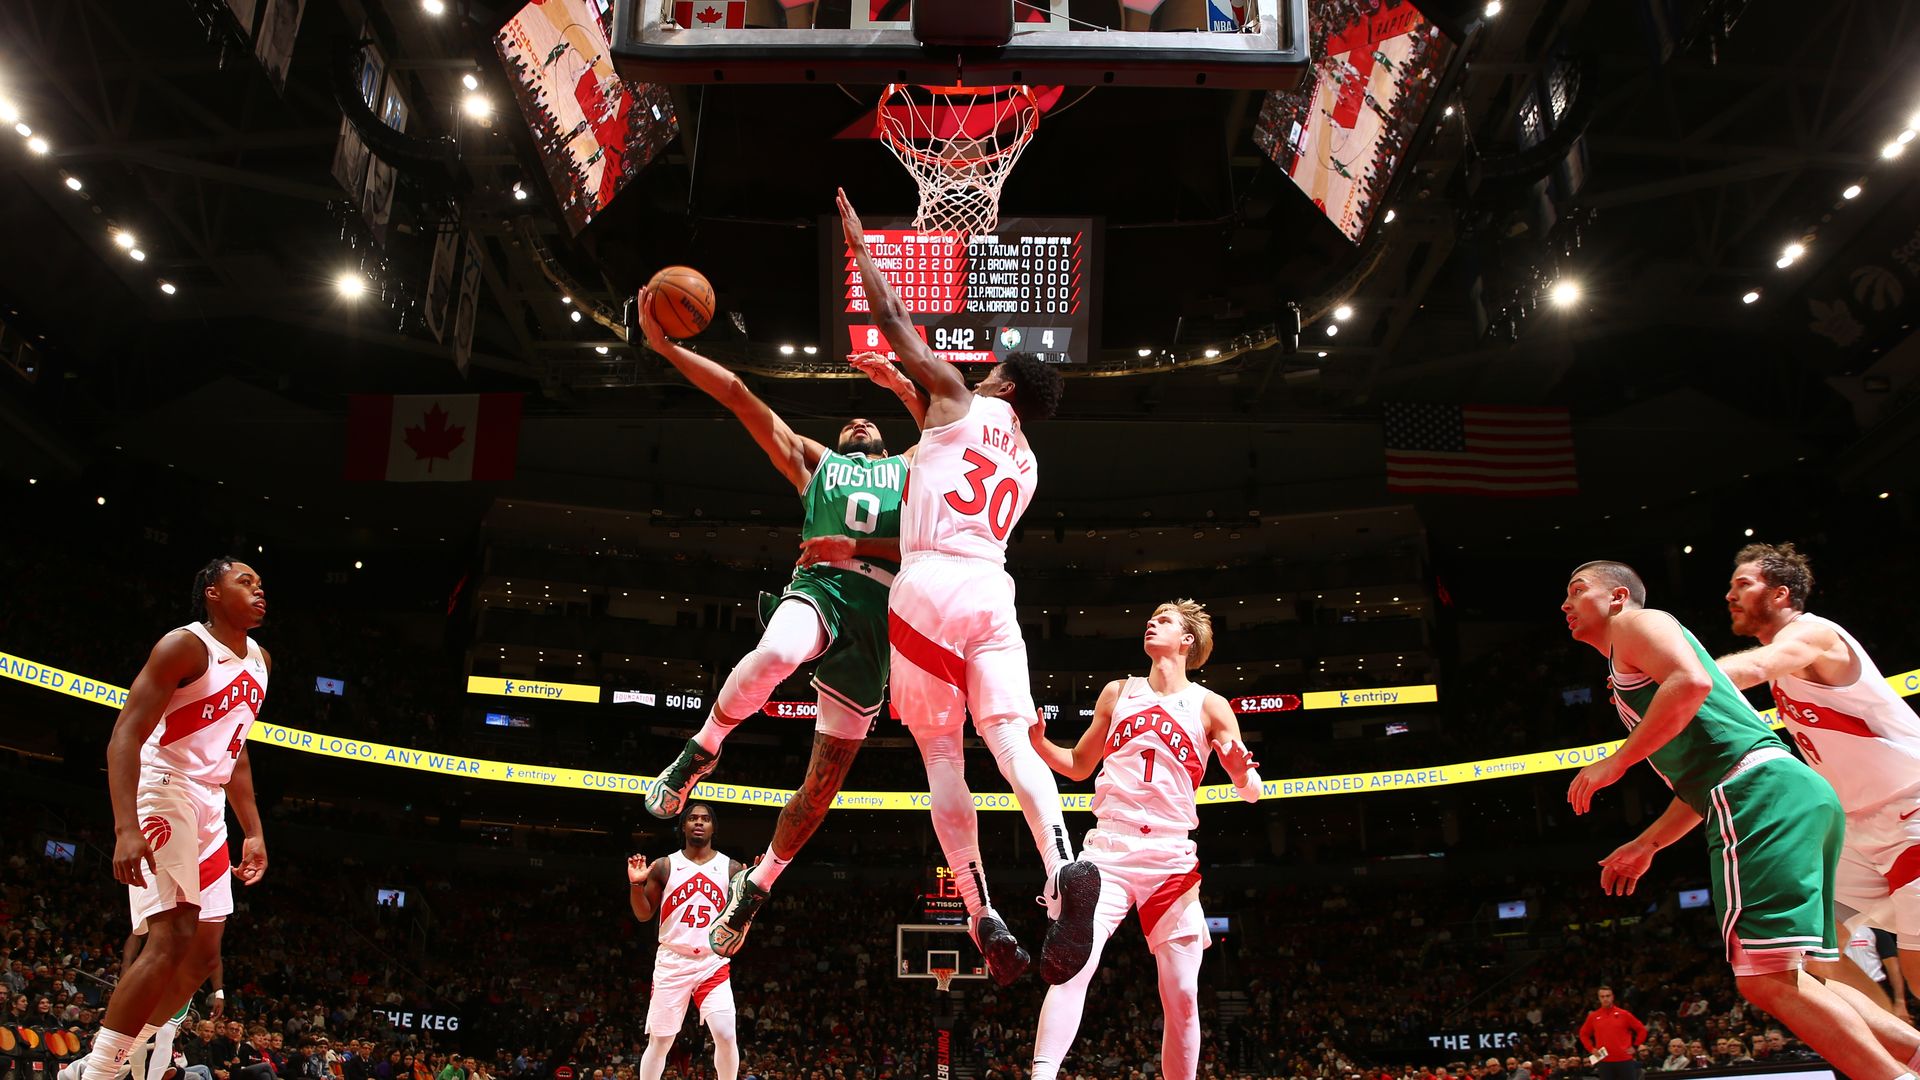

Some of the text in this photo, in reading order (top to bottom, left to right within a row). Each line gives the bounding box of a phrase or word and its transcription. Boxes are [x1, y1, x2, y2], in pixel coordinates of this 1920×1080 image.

[1213, 20, 1233, 32] NBA
[876, 244, 902, 256] DICK
[906, 244, 914, 256] 5
[920, 244, 926, 256] 1
[932, 244, 940, 256] 0
[944, 244, 952, 256] 0
[969, 244, 1068, 257] 0 J. TATUM 0 0 0 1
[906, 258, 914, 270] 0
[919, 258, 926, 270] 2
[932, 258, 940, 270] 2
[944, 258, 952, 270] 0
[969, 259, 1069, 271] 7 J. BROWN 4 0 0 0
[906, 272, 914, 284] 0
[920, 272, 926, 284] 1
[932, 272, 938, 284] 1
[944, 272, 952, 284] 0
[969, 273, 1069, 284] 9 D. WHITE 0 0 0 0
[906, 286, 914, 298] 0
[919, 286, 927, 298] 0
[931, 286, 940, 298] 0
[945, 286, 951, 298] 1
[968, 286, 978, 298] 11
[1021, 286, 1030, 298] 0
[1035, 286, 1041, 298] 1
[1047, 286, 1056, 298] 0
[1060, 286, 1068, 298] 0
[852, 300, 862, 311] 45
[906, 300, 913, 311] 3
[919, 300, 927, 311] 0
[931, 300, 940, 311] 0
[944, 300, 952, 311] 0
[967, 301, 978, 312] 42
[986, 301, 1017, 312] HORFORD
[1021, 301, 1029, 312] 0
[1035, 301, 1041, 312] 1
[1047, 301, 1055, 312] 0
[1060, 301, 1068, 312] 0
[867, 328, 879, 346] 8
[935, 328, 974, 350] 9:42
[985, 330, 990, 340] 1
[1042, 330, 1054, 348] 4
[948, 352, 989, 361] TISSOT
[1060, 353, 1065, 362] 7
[983, 424, 1031, 475] AGBAJI
[824, 462, 900, 491] BOSTON
[944, 448, 1019, 541] 30
[844, 492, 880, 534] 0
[70, 678, 128, 706] APPAR
[518, 683, 563, 698] entripy
[1354, 690, 1398, 703] entripy
[202, 680, 262, 720] RAPTOR
[1241, 698, 1283, 711] $2,500
[778, 704, 818, 716] $2,500
[226, 723, 244, 759] 4
[1113, 713, 1189, 762] RAPTORS
[264, 726, 481, 774] YOUR LOGO, ANY WEAR
[1555, 747, 1607, 765] YOUR
[1140, 748, 1155, 782] 1
[1486, 761, 1526, 773] entripy
[518, 769, 556, 782] entripy
[1206, 769, 1448, 800] CUSM BRANDED APPAREL
[694, 785, 736, 799] NDED
[742, 790, 792, 805] APPAR
[847, 795, 884, 806] entripy
[1062, 796, 1094, 807] WEA
[974, 796, 1015, 808] OGO,
[672, 878, 721, 907] RAPTORS
[680, 905, 711, 928] 45
[421, 1014, 459, 1031] KEG
[1428, 1035, 1471, 1050] THE
